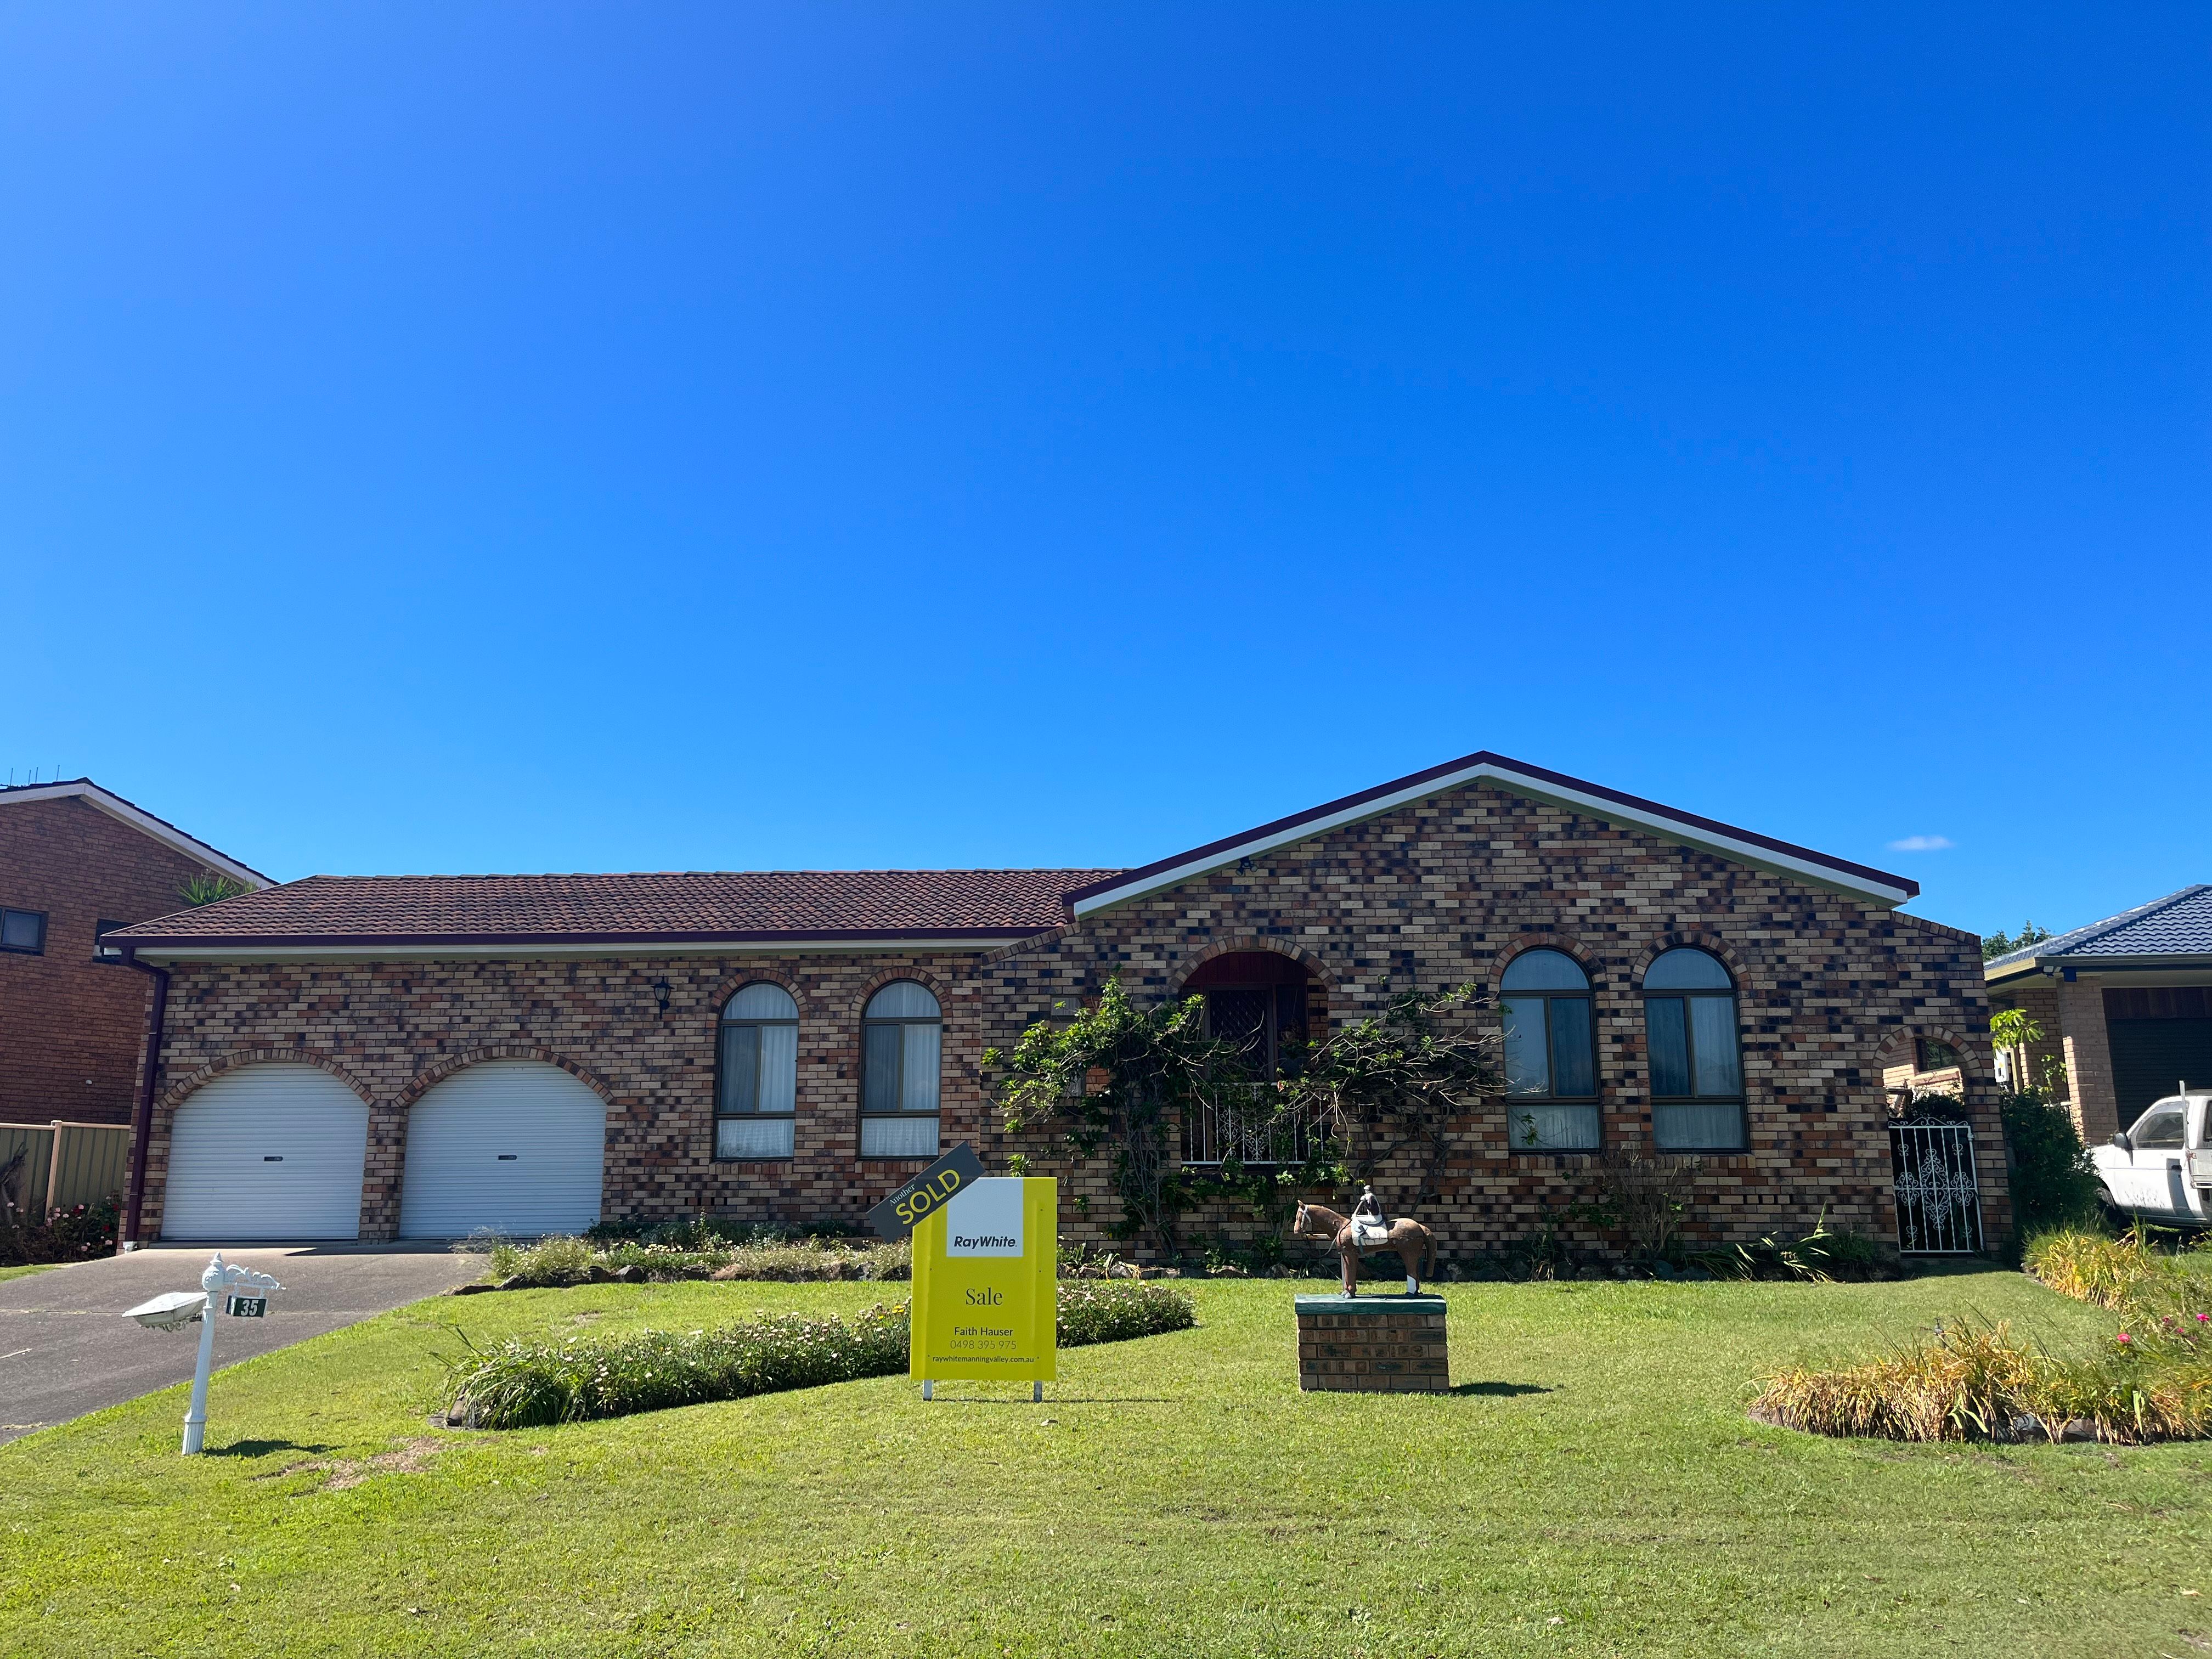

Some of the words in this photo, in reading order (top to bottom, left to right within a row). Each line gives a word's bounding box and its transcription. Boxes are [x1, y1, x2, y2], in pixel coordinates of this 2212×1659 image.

[889, 1184, 916, 1207] Another
[895, 1169, 961, 1225] SOLD
[954, 1236, 1016, 1249] RayWhite
[966, 1287, 1003, 1305] Sale
[240, 1299, 259, 1316] 35
[954, 1327, 978, 1336] Faith
[980, 1327, 1014, 1336] Hauser
[950, 1340, 974, 1350] 0498
[978, 1340, 995, 1350] 395
[998, 1340, 1017, 1350] 975
[933, 1355, 1034, 1364] raywhitemanningvalley.com.au
